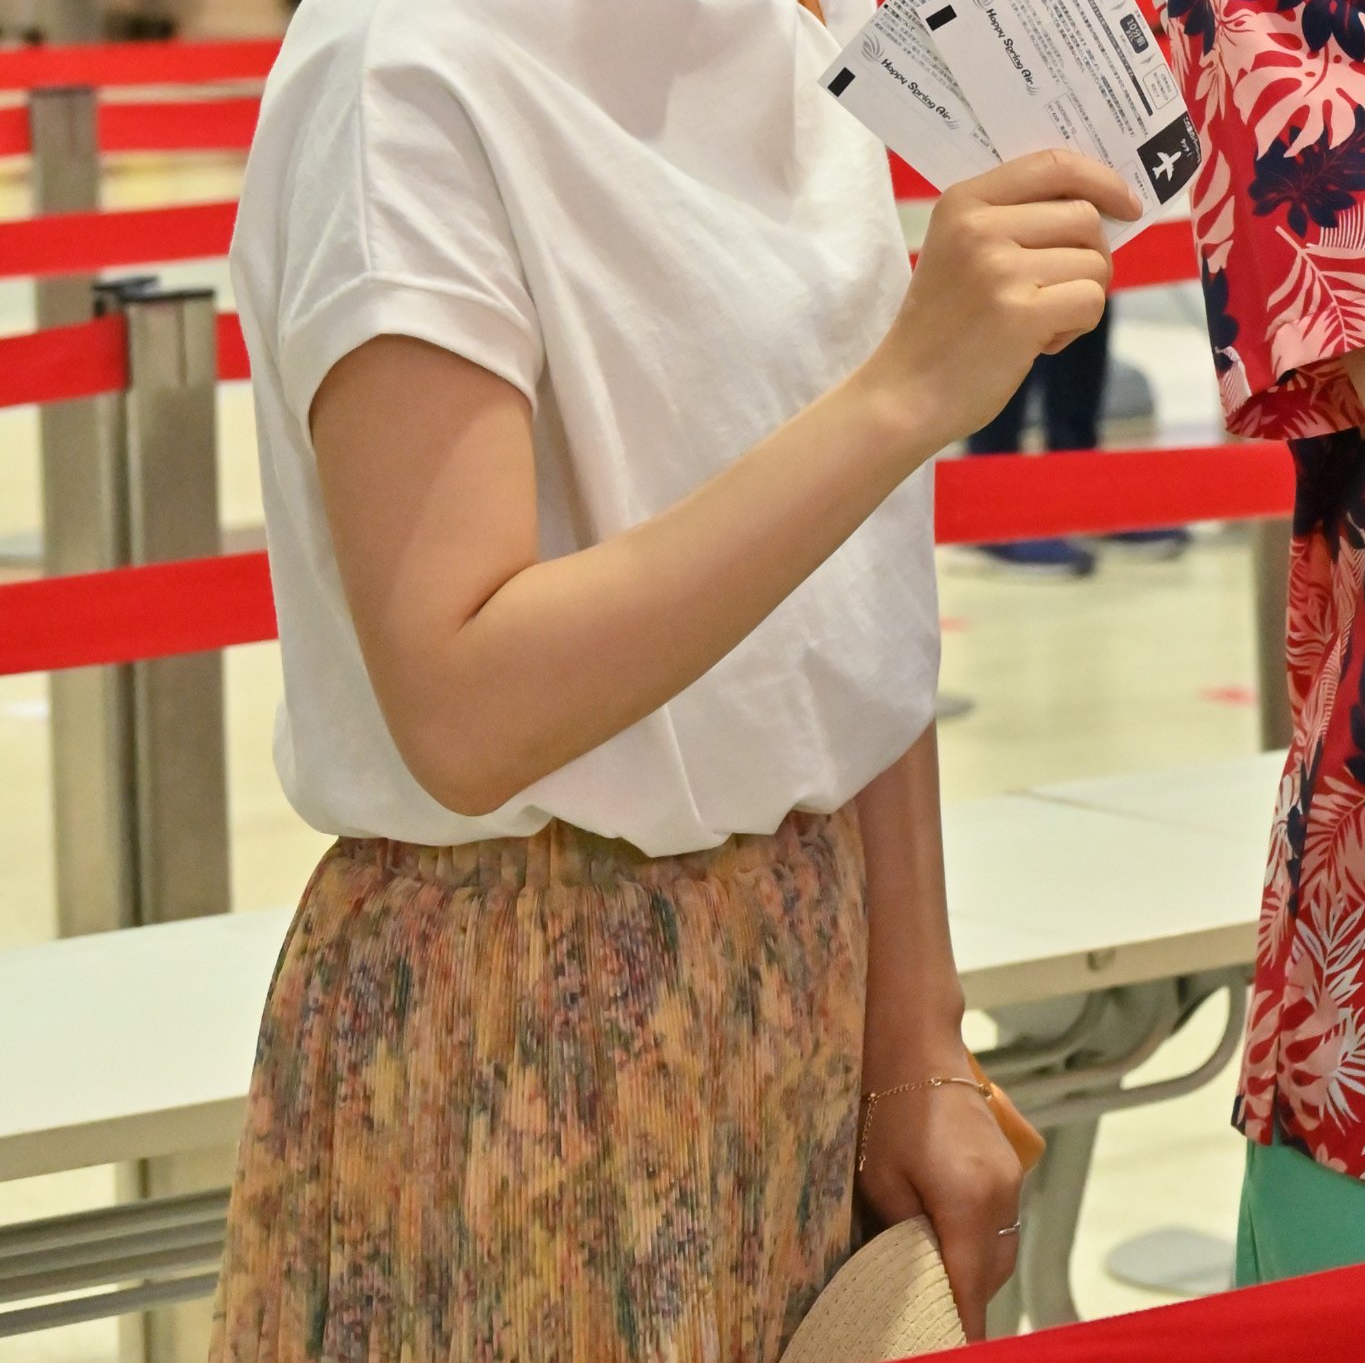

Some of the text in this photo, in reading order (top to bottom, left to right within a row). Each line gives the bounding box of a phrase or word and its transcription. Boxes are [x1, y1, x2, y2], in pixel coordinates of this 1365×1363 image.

[1003, 38, 1024, 69] Spring
[1021, 69, 1035, 85] Air
[908, 82, 935, 109] Spring
[936, 106, 951, 121] Air
